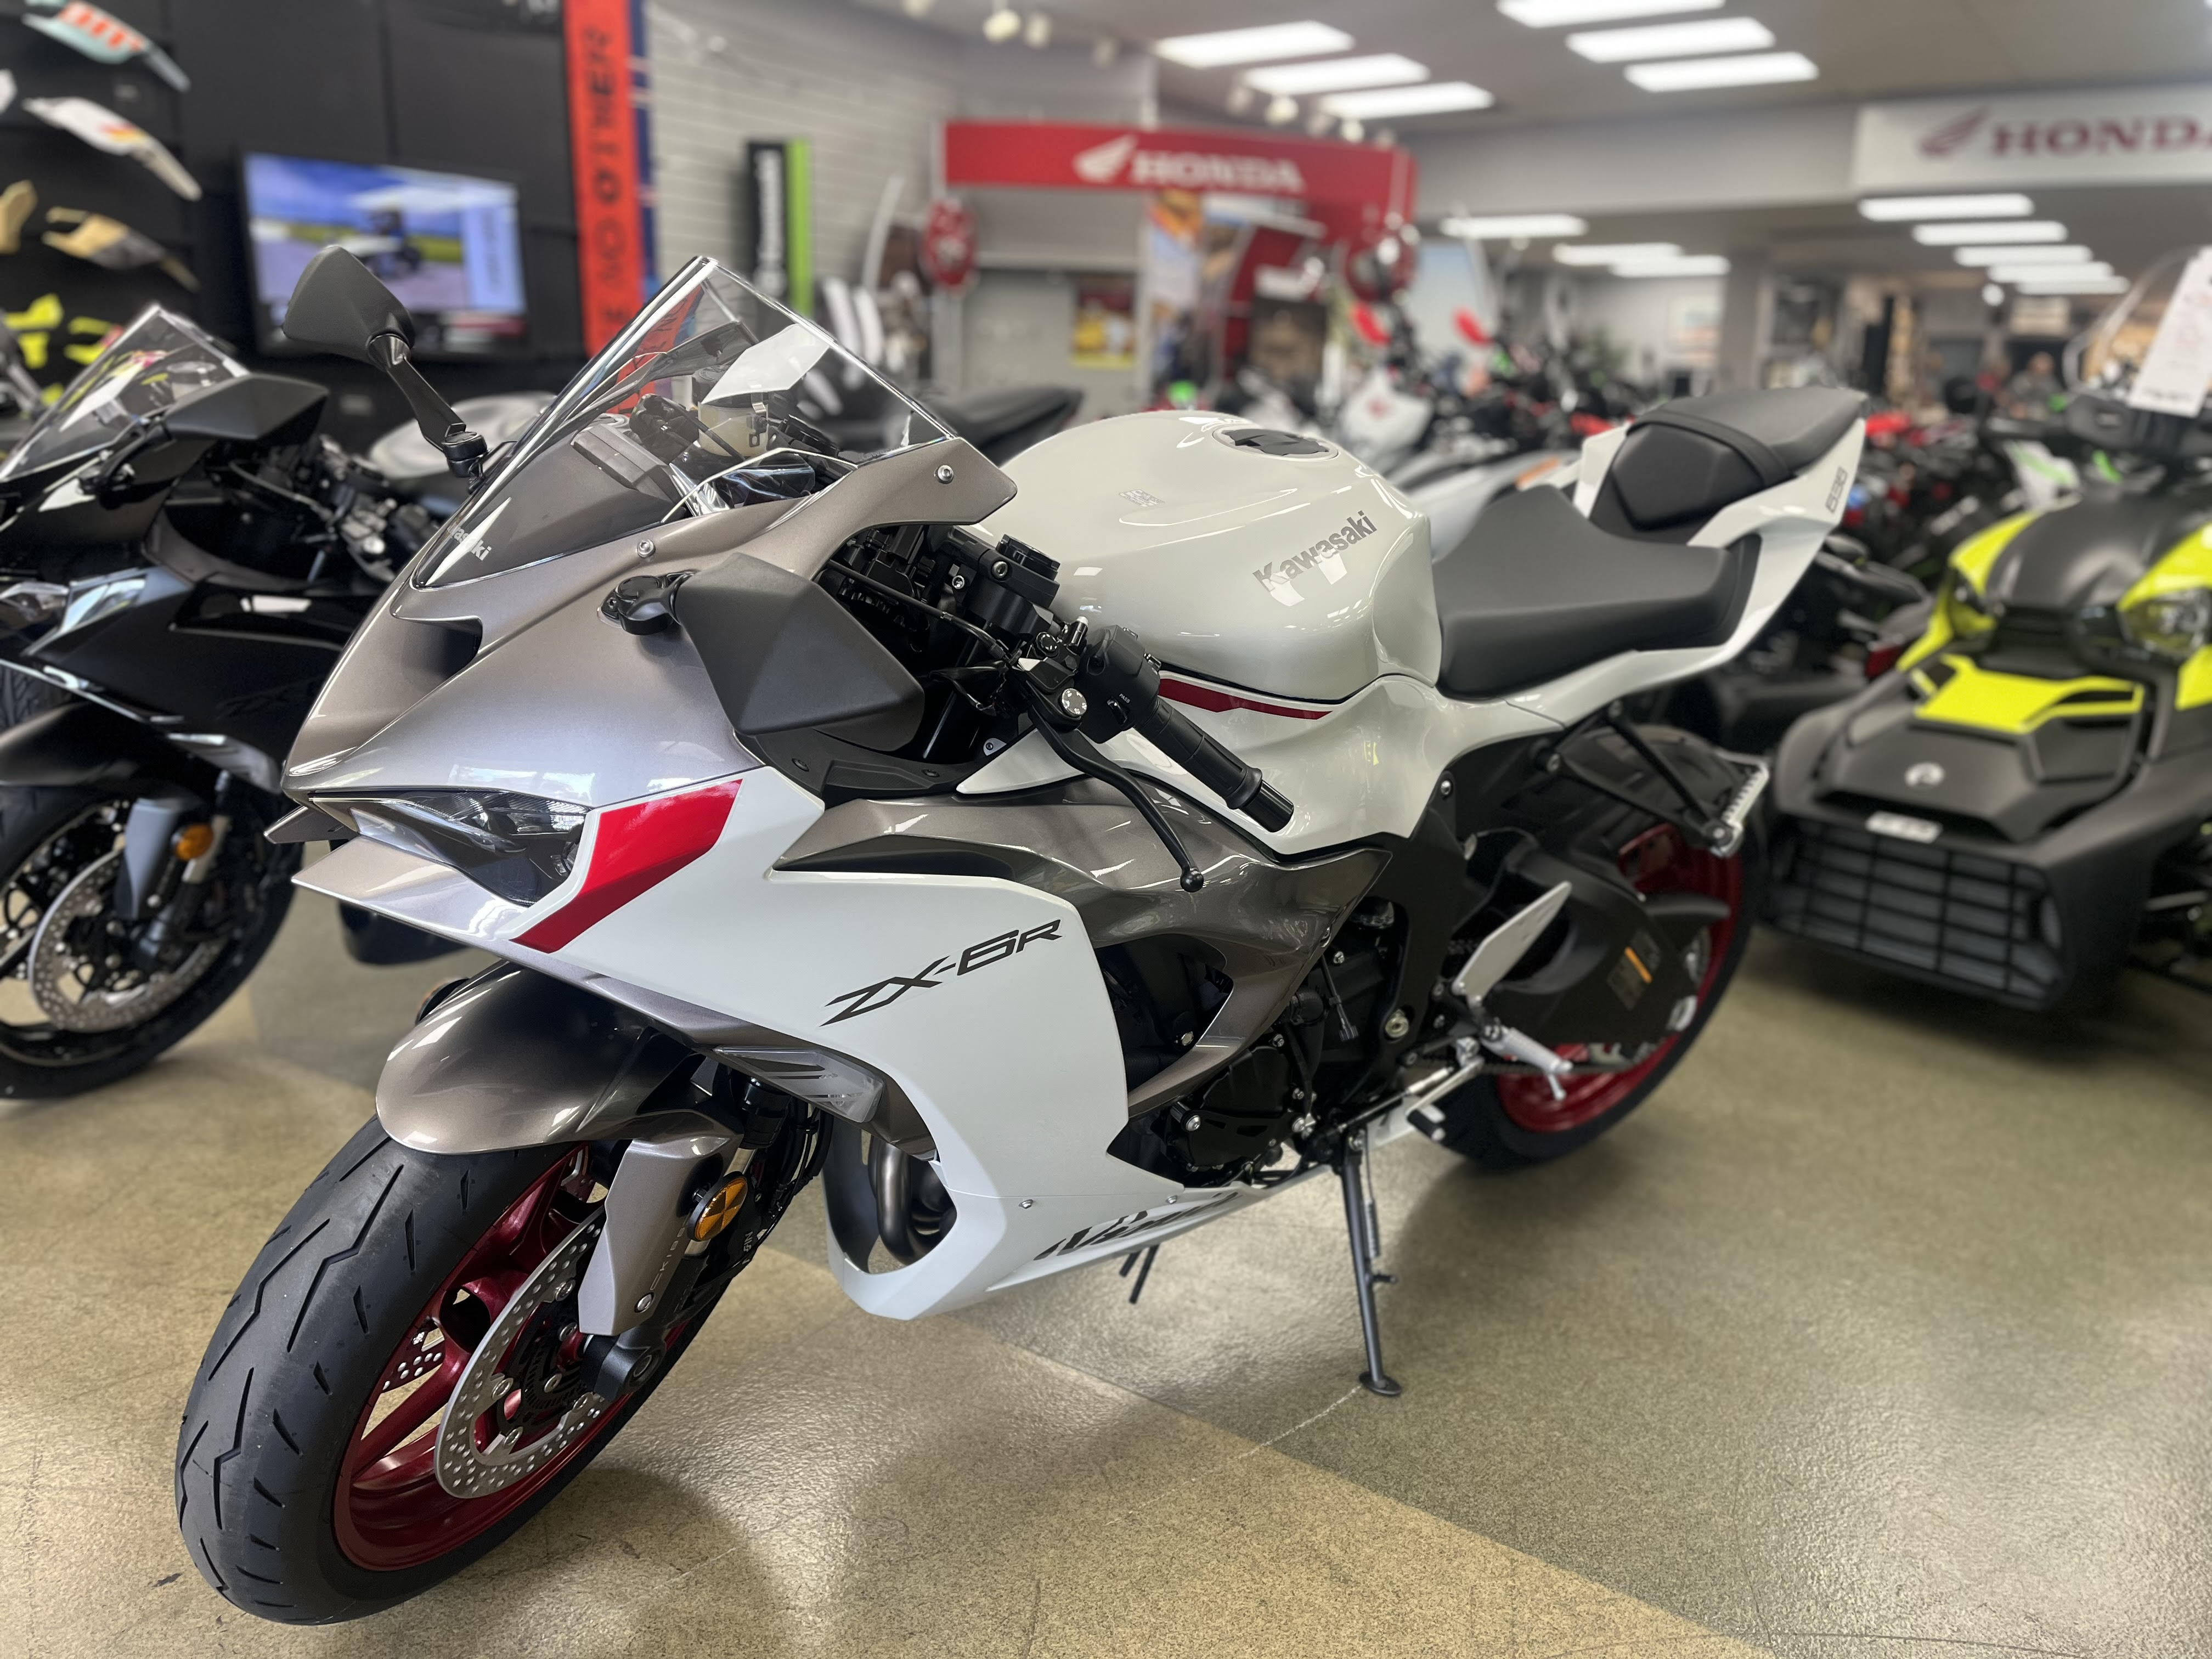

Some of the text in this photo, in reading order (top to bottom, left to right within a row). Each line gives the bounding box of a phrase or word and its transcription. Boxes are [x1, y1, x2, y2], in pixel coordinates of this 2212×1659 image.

[1991, 116, 2212, 159] HOND
[1131, 149, 1306, 193] HONDA
[1252, 510, 1377, 592] Kawasaki
[1119, 693, 1131, 703] PASS
[819, 919, 1063, 1027] ZX-6R
